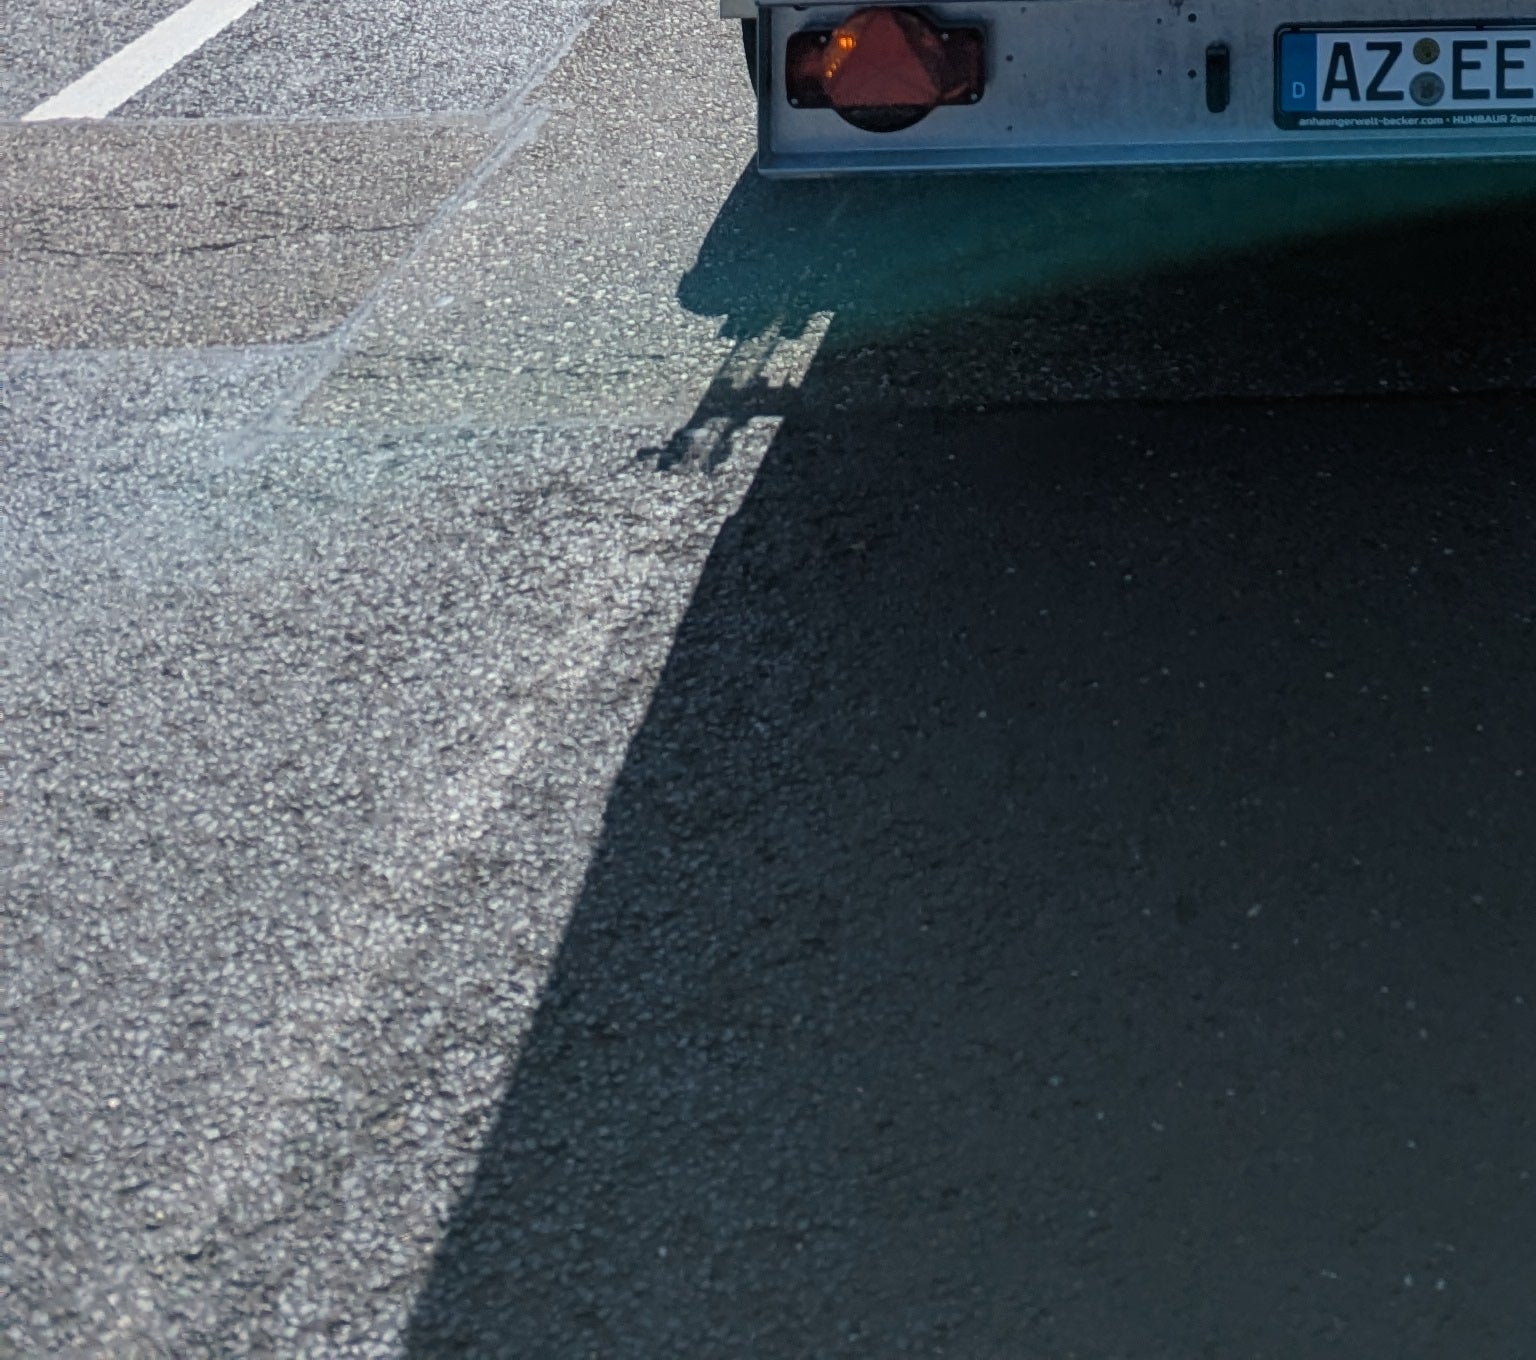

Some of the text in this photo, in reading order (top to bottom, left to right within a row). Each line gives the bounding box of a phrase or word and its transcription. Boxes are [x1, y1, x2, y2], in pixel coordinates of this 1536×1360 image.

[1292, 82, 1306, 99] D
[1322, 41, 1404, 102] AZ
[1451, 39, 1534, 100] EE
[1453, 115, 1508, 124] HUMBAUR
